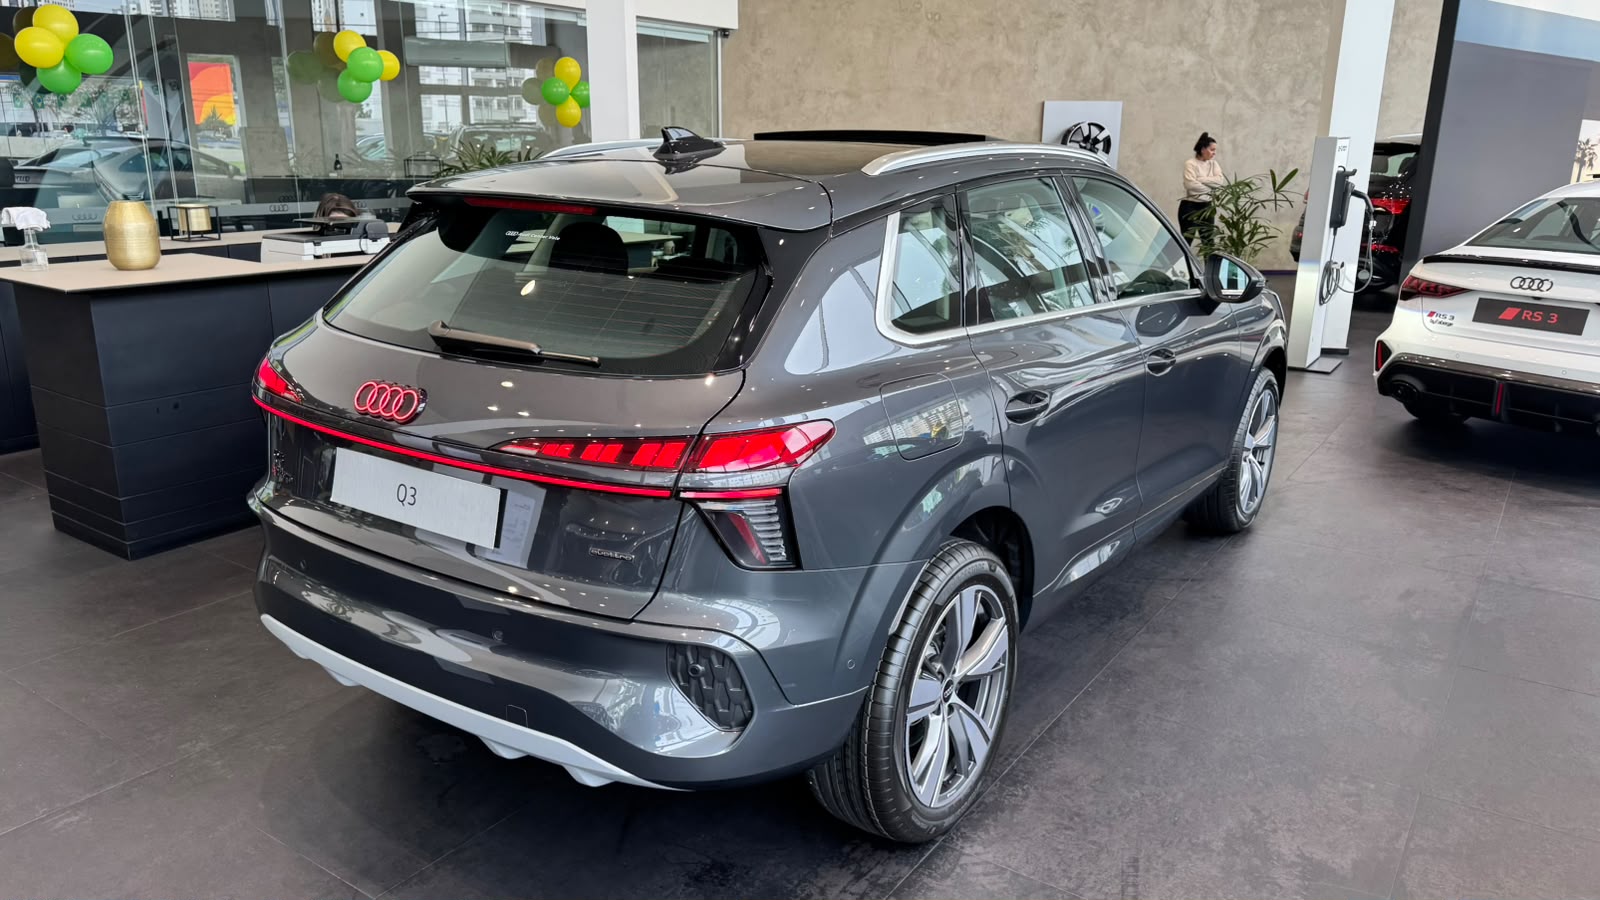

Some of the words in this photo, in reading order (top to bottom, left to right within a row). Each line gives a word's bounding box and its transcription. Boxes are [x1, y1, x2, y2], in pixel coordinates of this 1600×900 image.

[1521, 309, 1544, 322] RS
[1547, 313, 1559, 324] 3
[396, 483, 417, 507] Q3
